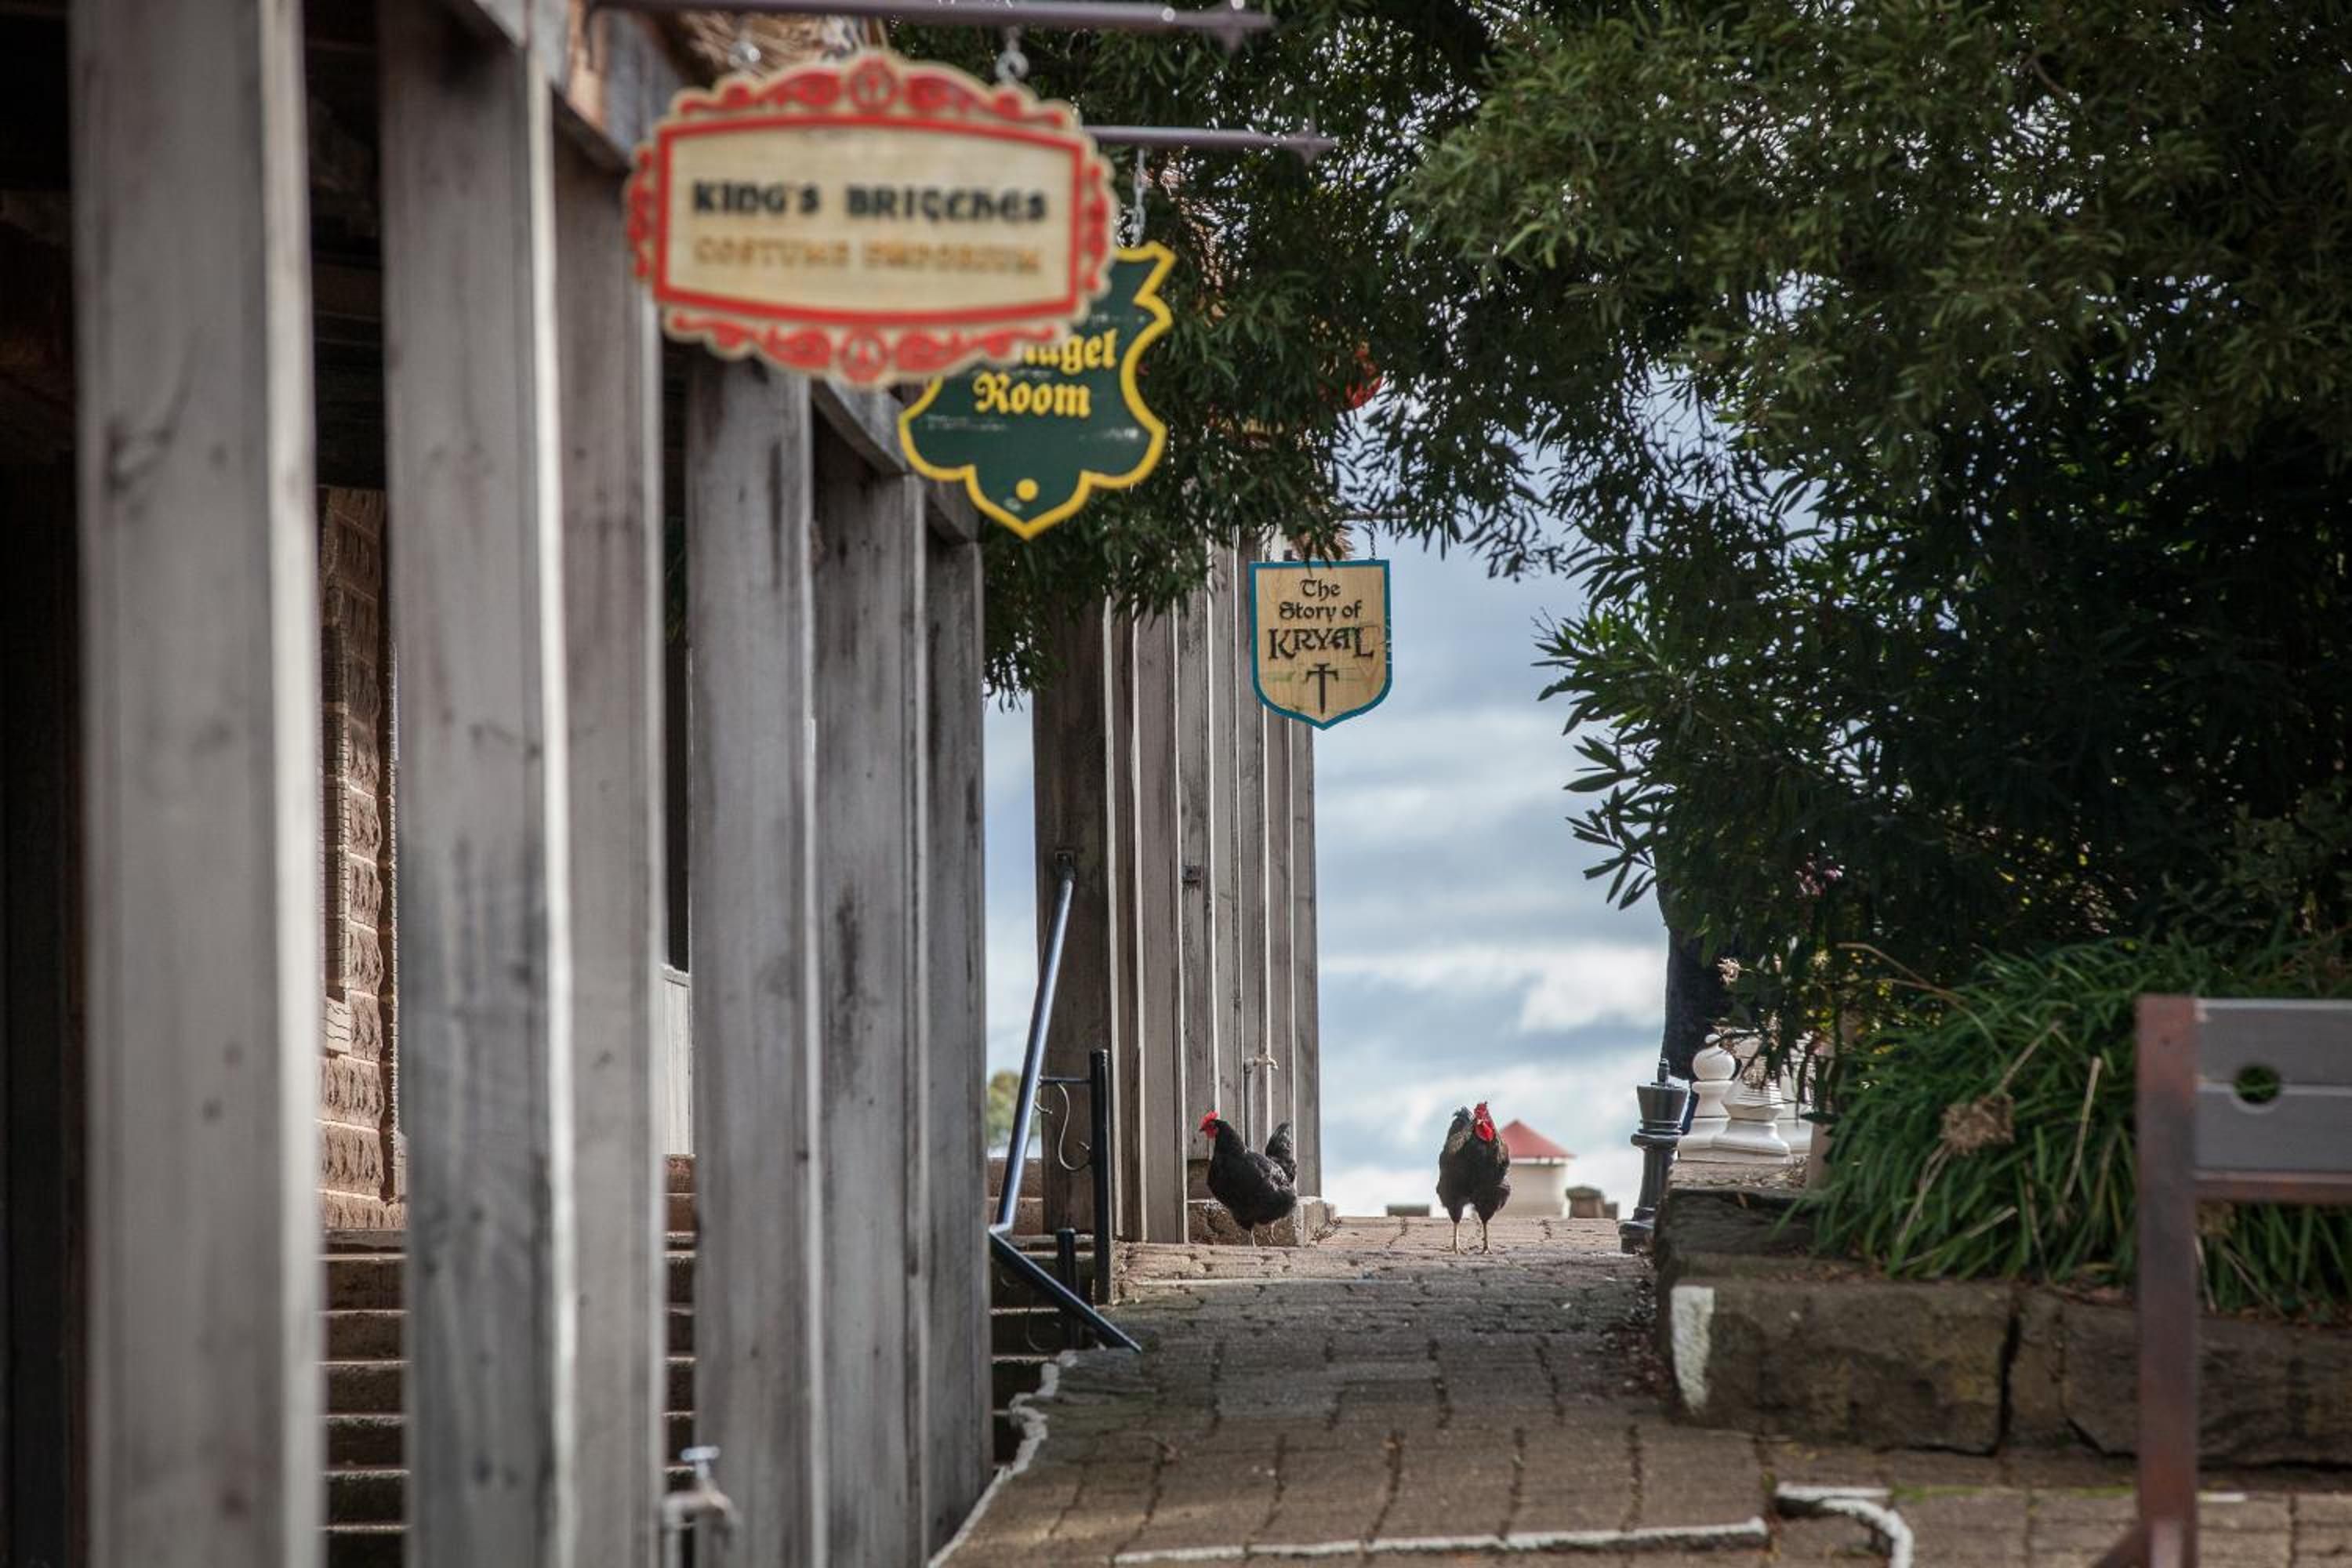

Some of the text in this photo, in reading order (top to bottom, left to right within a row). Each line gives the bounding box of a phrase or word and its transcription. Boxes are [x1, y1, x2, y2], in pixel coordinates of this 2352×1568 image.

[972, 372, 1091, 418] Room
[1300, 578, 1341, 602] The
[1279, 600, 1363, 622] Story of
[1268, 626, 1374, 660] KRYAL
